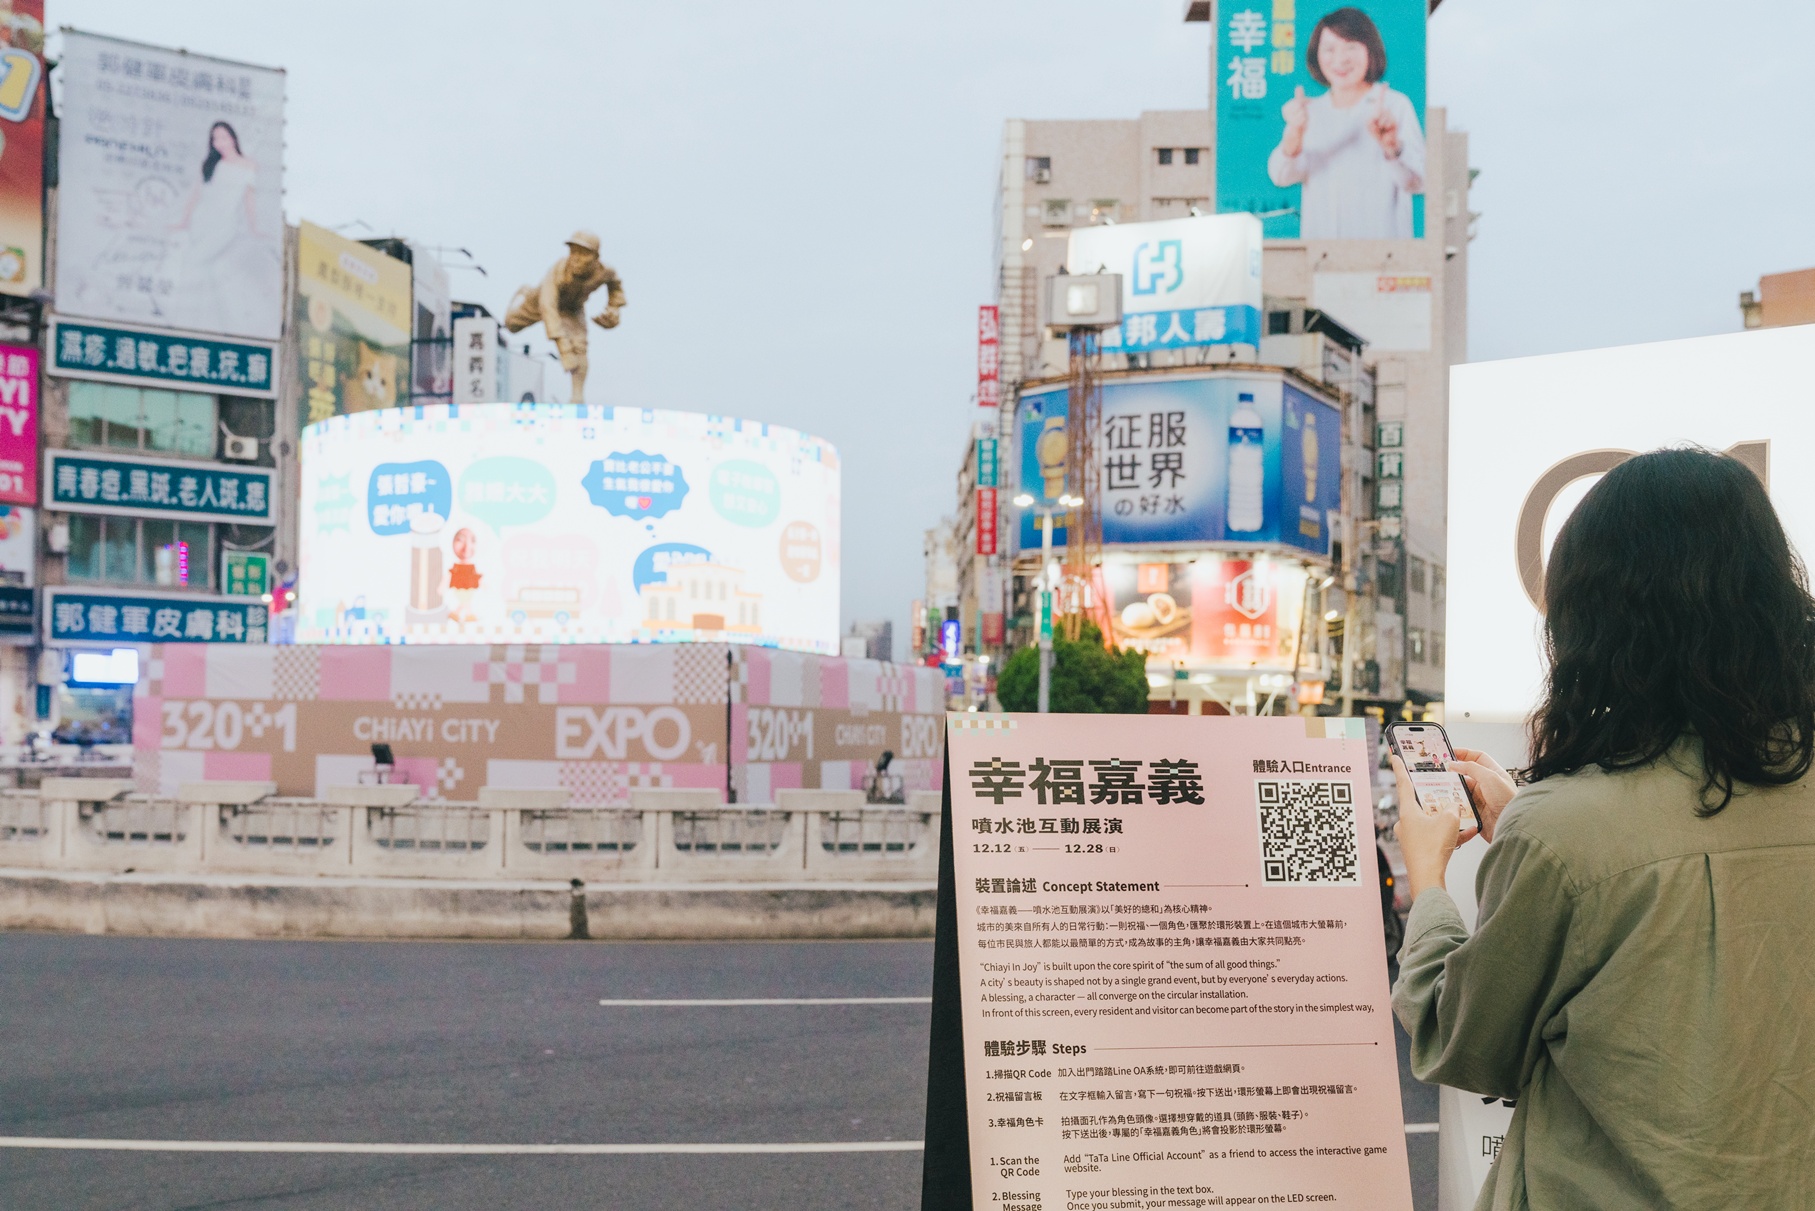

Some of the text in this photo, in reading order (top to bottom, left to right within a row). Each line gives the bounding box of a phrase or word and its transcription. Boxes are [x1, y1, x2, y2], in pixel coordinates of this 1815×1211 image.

[1227, 9, 1267, 100] 幸福
[1105, 411, 1186, 451] 征服
[1104, 452, 1186, 490] 世界
[1114, 494, 1185, 516] の好水
[556, 706, 691, 760] EXPO
[901, 715, 938, 757] EXPO
[969, 757, 1205, 805] 幸福嘉義
[972, 817, 1123, 835] 噴水池互動展演
[1042, 881, 1092, 894] Concept
[1096, 881, 1159, 891] Statement
[1044, 962, 1050, 970] is
[1052, 962, 1071, 970] built
[1073, 963, 1095, 972] upon
[1097, 961, 1111, 970] the
[1132, 960, 1154, 971] spirit
[1155, 960, 1164, 969] of
[1204, 959, 1213, 968] of
[1214, 960, 1225, 968] all
[1226, 959, 1247, 970] good
[980, 978, 986, 986] A
[1014, 977, 1043, 988] beauty
[1045, 977, 1052, 986] is
[1054, 977, 1084, 987] shaped
[1086, 977, 1101, 985] not
[1103, 976, 1112, 987] by
[1121, 975, 1146, 987] single
[1147, 975, 1171, 986] grand
[1173, 976, 1199, 985] event,
[1200, 974, 1215, 984] but
[1217, 974, 1227, 985] by
[1276, 973, 1314, 984] everyday
[1316, 973, 1347, 982] actions.
[981, 994, 987, 1002] A
[988, 993, 1026, 1004] blessing,
[1035, 992, 1075, 1001] character
[1086, 992, 1097, 1000] all
[1098, 993, 1137, 1002] converge
[1151, 990, 1165, 999] the
[1166, 990, 1198, 999] circular
[1200, 989, 1248, 998] installation.
[982, 1009, 990, 1017] In
[992, 1008, 1013, 1017] front
[1014, 1008, 1023, 1017] of
[1024, 1008, 1040, 1016] this
[1042, 1009, 1072, 1017] screen,
[1074, 1008, 1097, 1018] every
[1098, 1006, 1133, 1015] resident
[1134, 1006, 1150, 1015] and
[1152, 1005, 1178, 1014] visitor
[1196, 1005, 1229, 1013] become
[1230, 1005, 1247, 1015] part
[1248, 1004, 1257, 1013] of
[1258, 1004, 1272, 1012] the
[1273, 1004, 1294, 1014] story
[1295, 1003, 1303, 1012] in
[1304, 1003, 1318, 1012] the
[1320, 1002, 1354, 1013] simplest
[1355, 1004, 1374, 1013] way,
[1052, 1043, 1086, 1054] Steps
[1000, 1156, 1022, 1165] Scan
[1024, 1155, 1039, 1164] the
[1063, 1154, 1080, 1164] Add
[1111, 1152, 1130, 1161] Line
[1132, 1151, 1164, 1161] Official
[1229, 1148, 1254, 1158] friend
[1257, 1149, 1266, 1157] to
[1299, 1147, 1313, 1156] the
[1316, 1146, 1361, 1155] interactive
[1363, 1146, 1387, 1156] game
[1000, 1168, 1039, 1178] QR Code
[1064, 1164, 1101, 1172] website.
[1002, 1191, 1040, 1201] Blessing
[1066, 1184, 1213, 1200] Type your blessing in the text box.
[1066, 1201, 1089, 1210] Once
[1091, 1202, 1107, 1210] you
[1110, 1198, 1143, 1210] submit,
[1145, 1200, 1165, 1209] your
[1168, 1198, 1206, 1208] message
[1207, 1196, 1223, 1205] will
[1225, 1197, 1256, 1206] appear
[1270, 1194, 1285, 1203] the
[1287, 1193, 1303, 1202] LED
[1305, 1194, 1336, 1202] screen.
